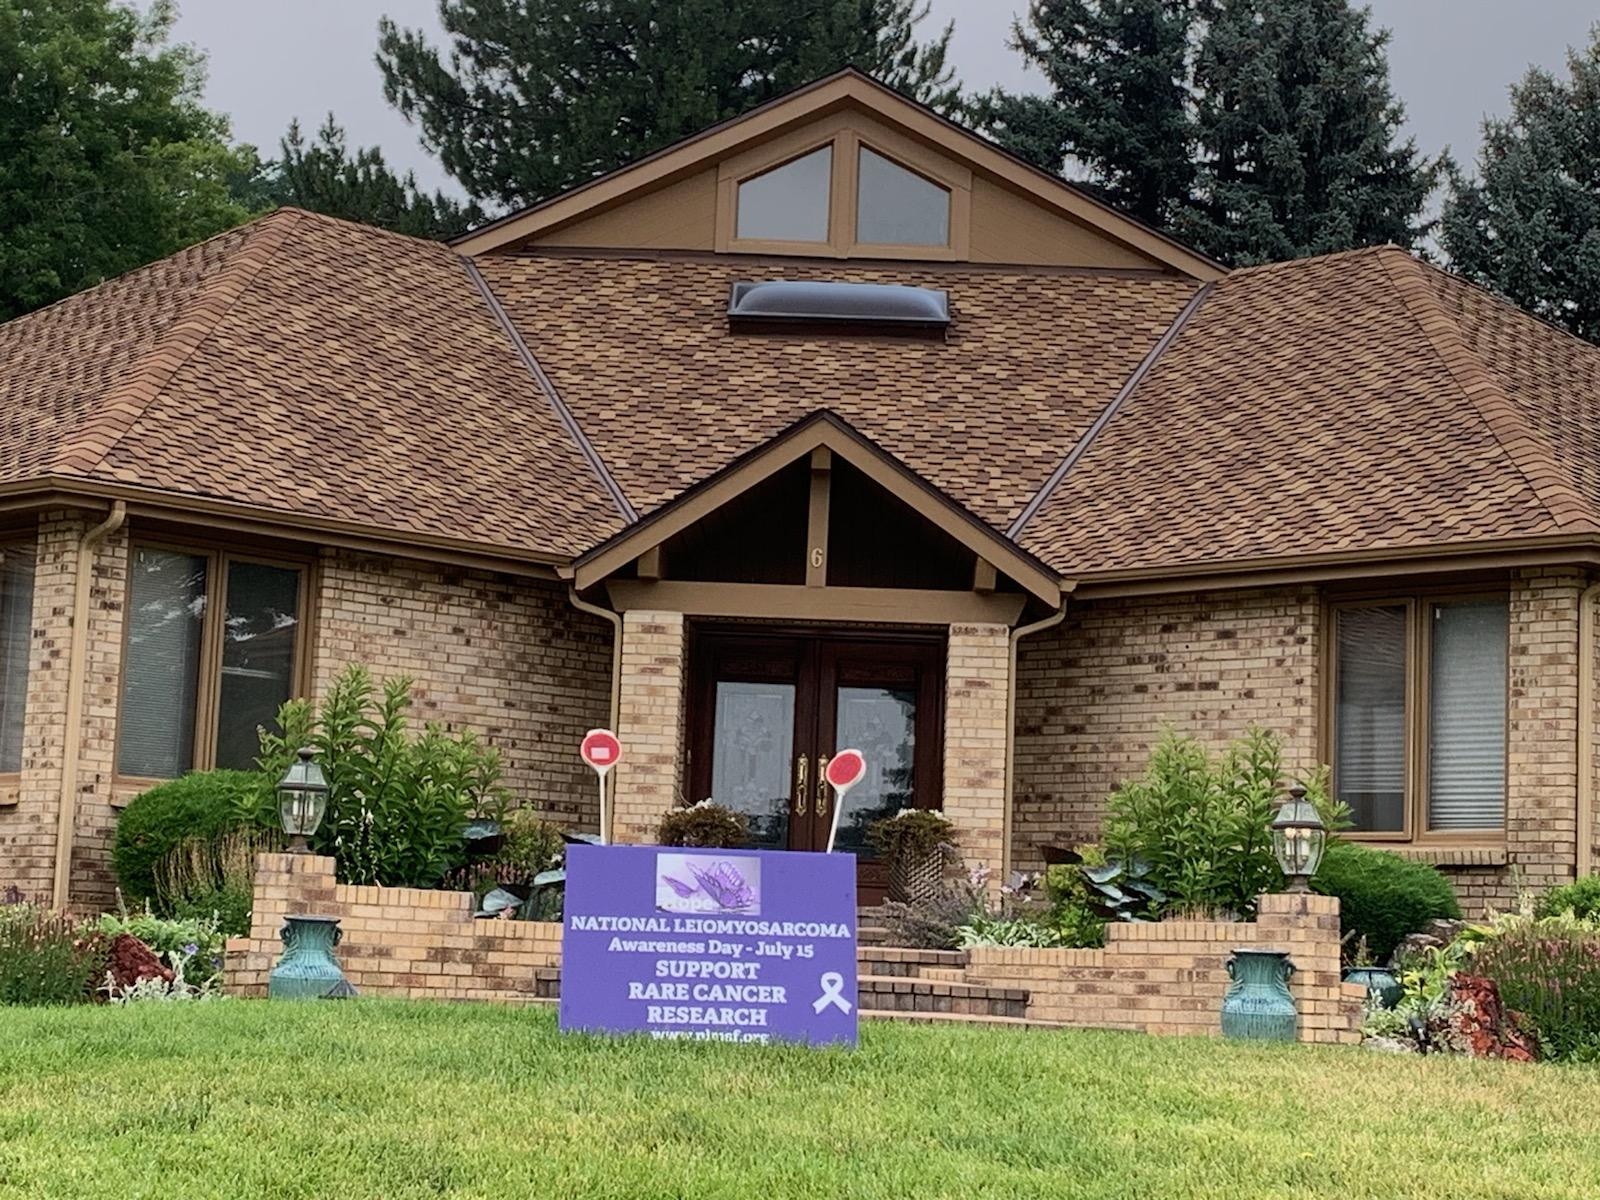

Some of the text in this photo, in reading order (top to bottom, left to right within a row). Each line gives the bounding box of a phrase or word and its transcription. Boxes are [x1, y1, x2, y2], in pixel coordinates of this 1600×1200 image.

[811, 547, 823, 568] 6
[570, 915, 852, 938] NATIONAL LEIOMYOSARCOMA
[608, 936, 706, 953] Awareness
[708, 939, 744, 958] Day
[755, 941, 795, 960] July
[796, 944, 814, 959] 15
[655, 960, 761, 980] SUPPORT
[628, 982, 788, 1004] RARE CANCER
[647, 1006, 768, 1027] RESEARCH
